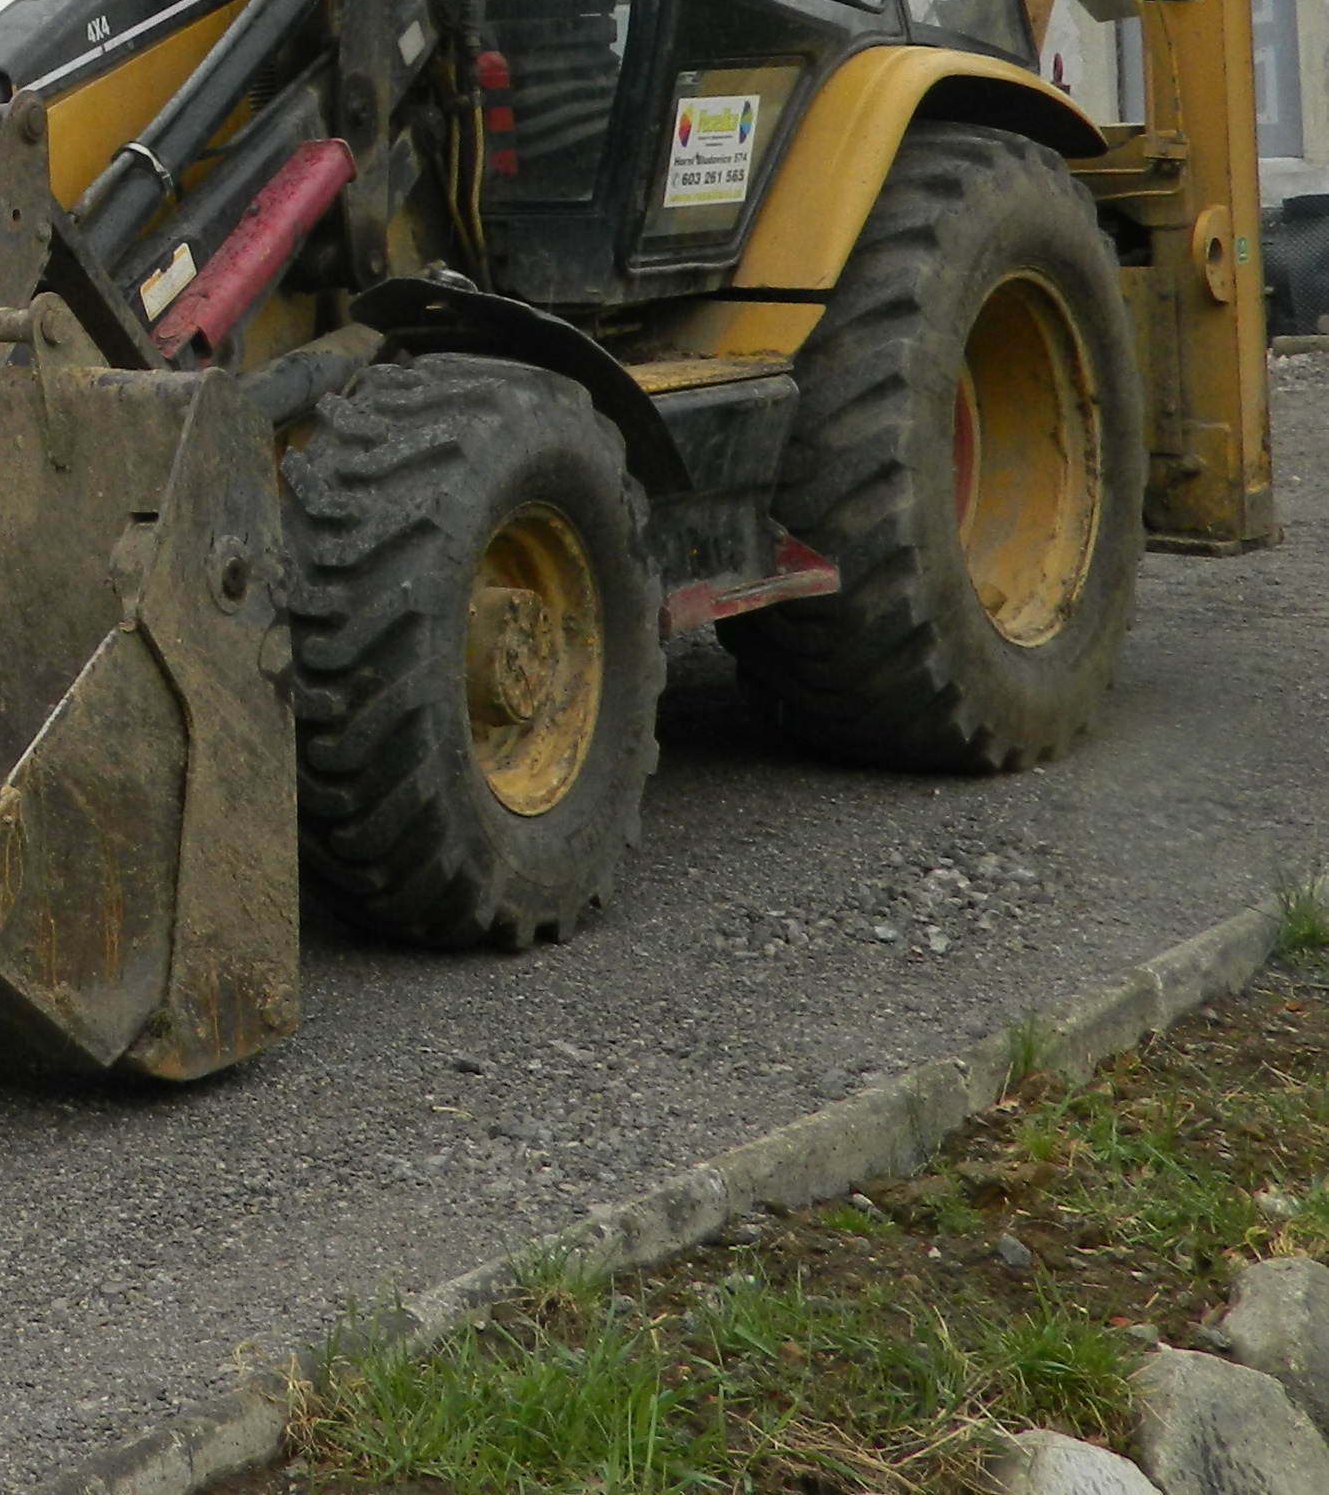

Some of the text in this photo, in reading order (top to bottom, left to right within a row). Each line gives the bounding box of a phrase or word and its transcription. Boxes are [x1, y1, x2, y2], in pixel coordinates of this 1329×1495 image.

[681, 168, 745, 186] 603 261 565
